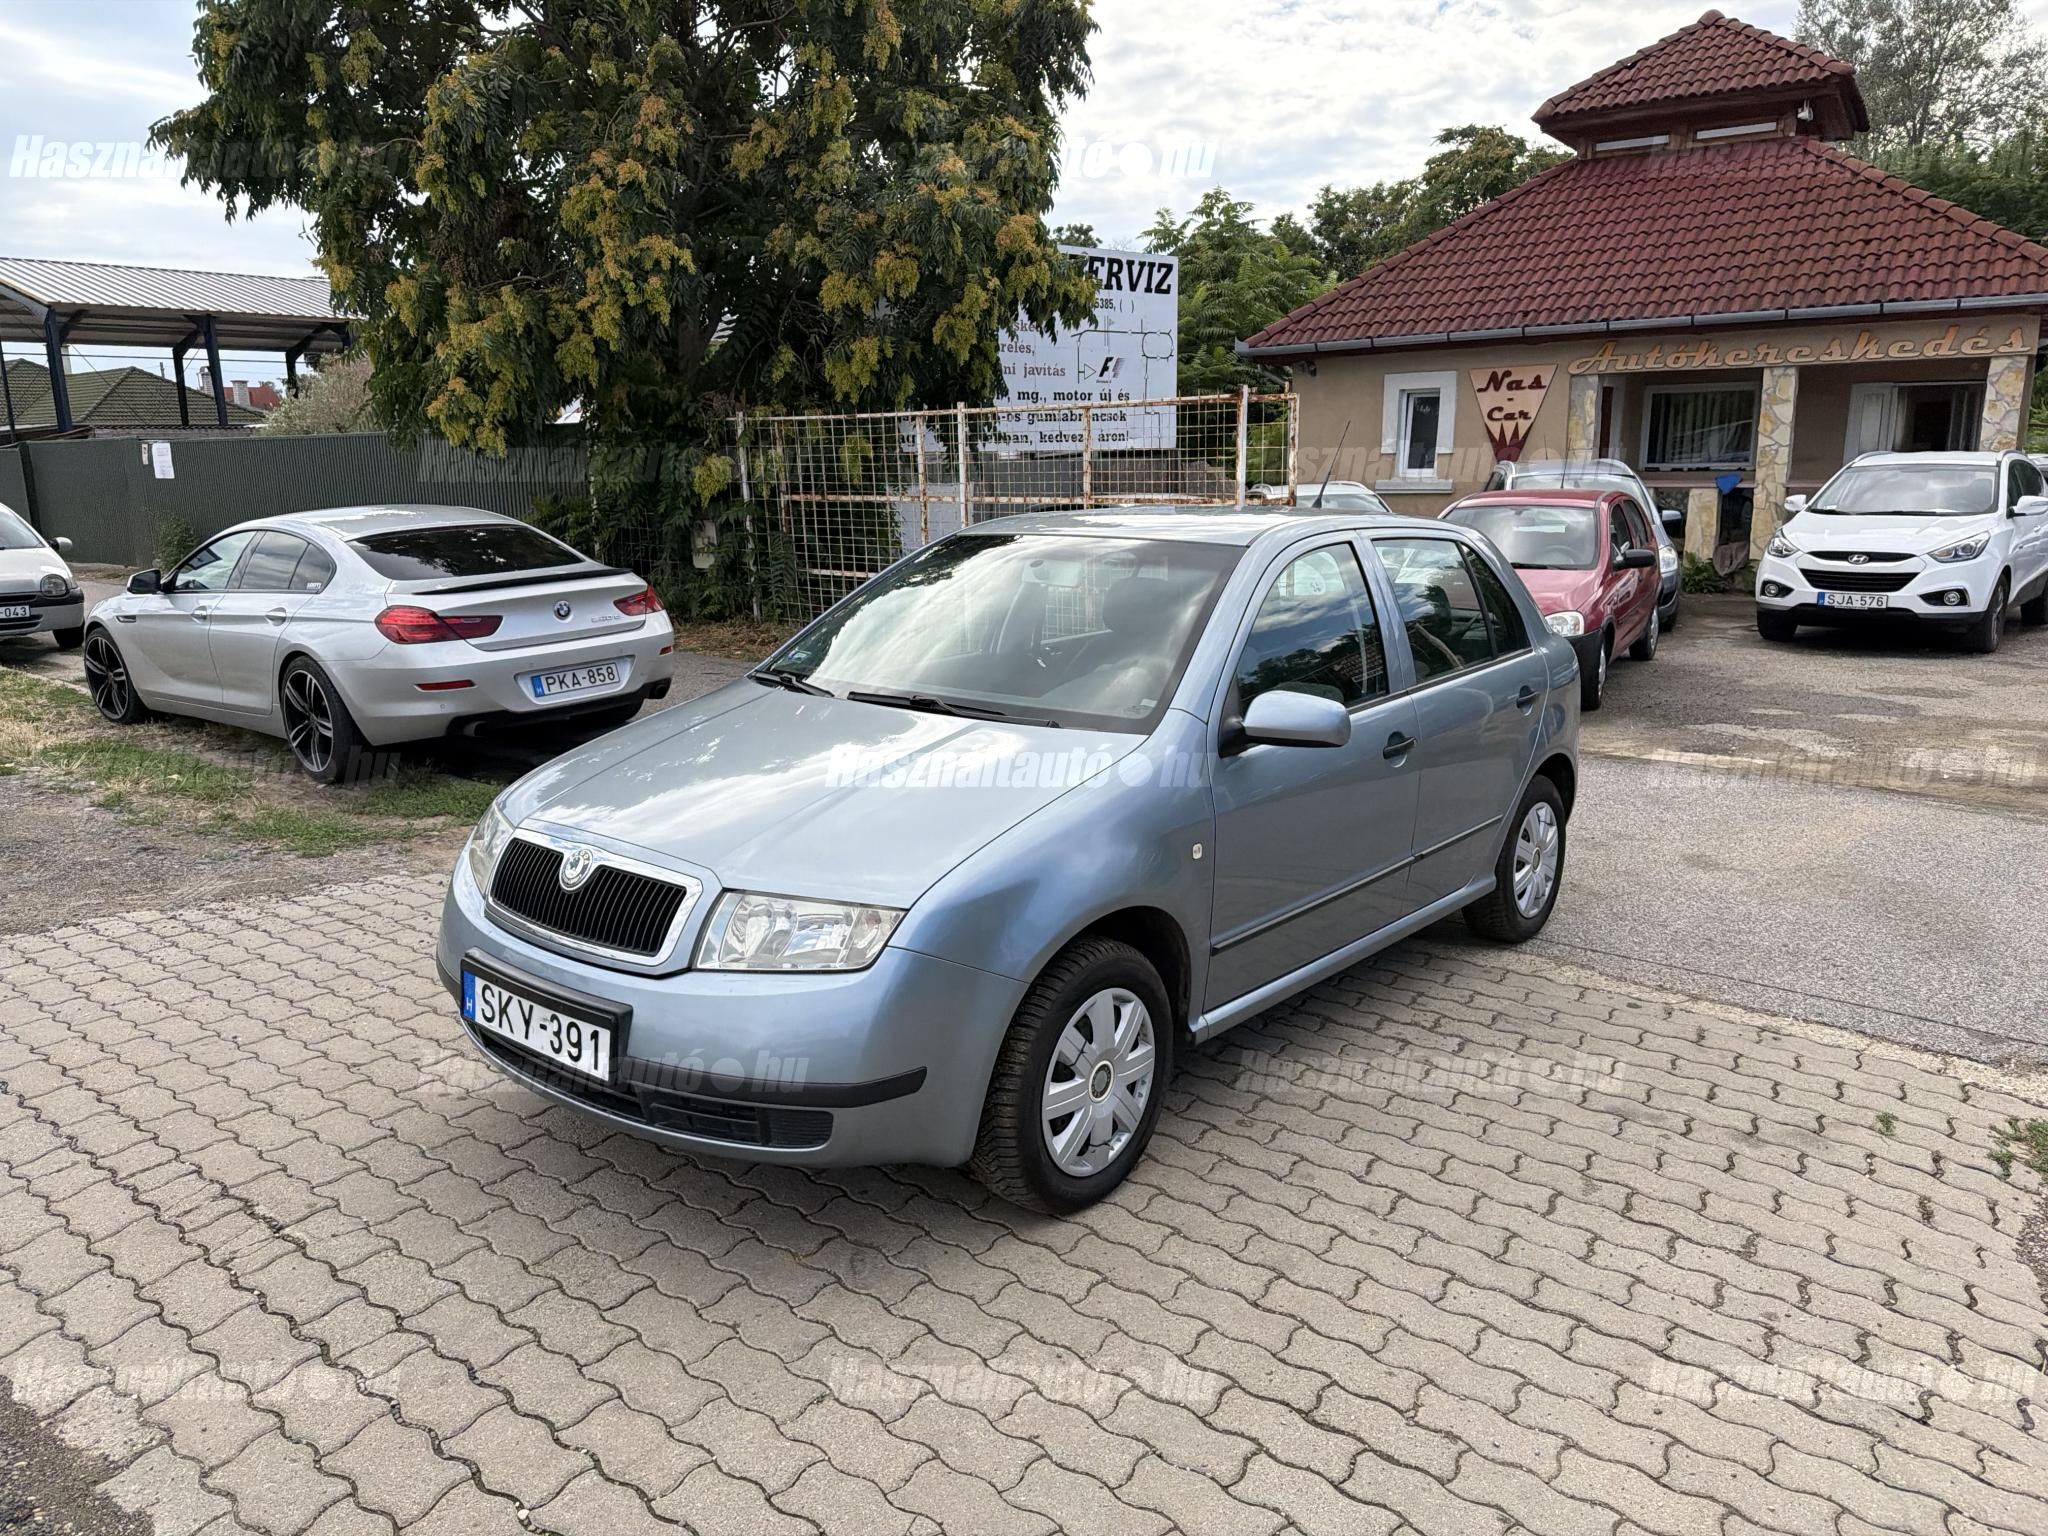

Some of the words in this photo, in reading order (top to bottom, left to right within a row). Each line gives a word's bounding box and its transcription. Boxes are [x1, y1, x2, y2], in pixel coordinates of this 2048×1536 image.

[1567, 325, 2031, 376] Autókereskedés
[1024, 363, 1066, 377] javítás
[1477, 370, 1547, 393] Nas
[1053, 389, 1093, 401] motor
[1099, 388, 1112, 402] új
[1117, 389, 1130, 401] és
[1487, 406, 1532, 421] Car
[1039, 431, 1084, 443] kedvez
[1097, 429, 1129, 443] áron!
[1827, 594, 1884, 607] SJA-576
[545, 666, 616, 692] PKA-858
[481, 983, 600, 1071] SKY-391
